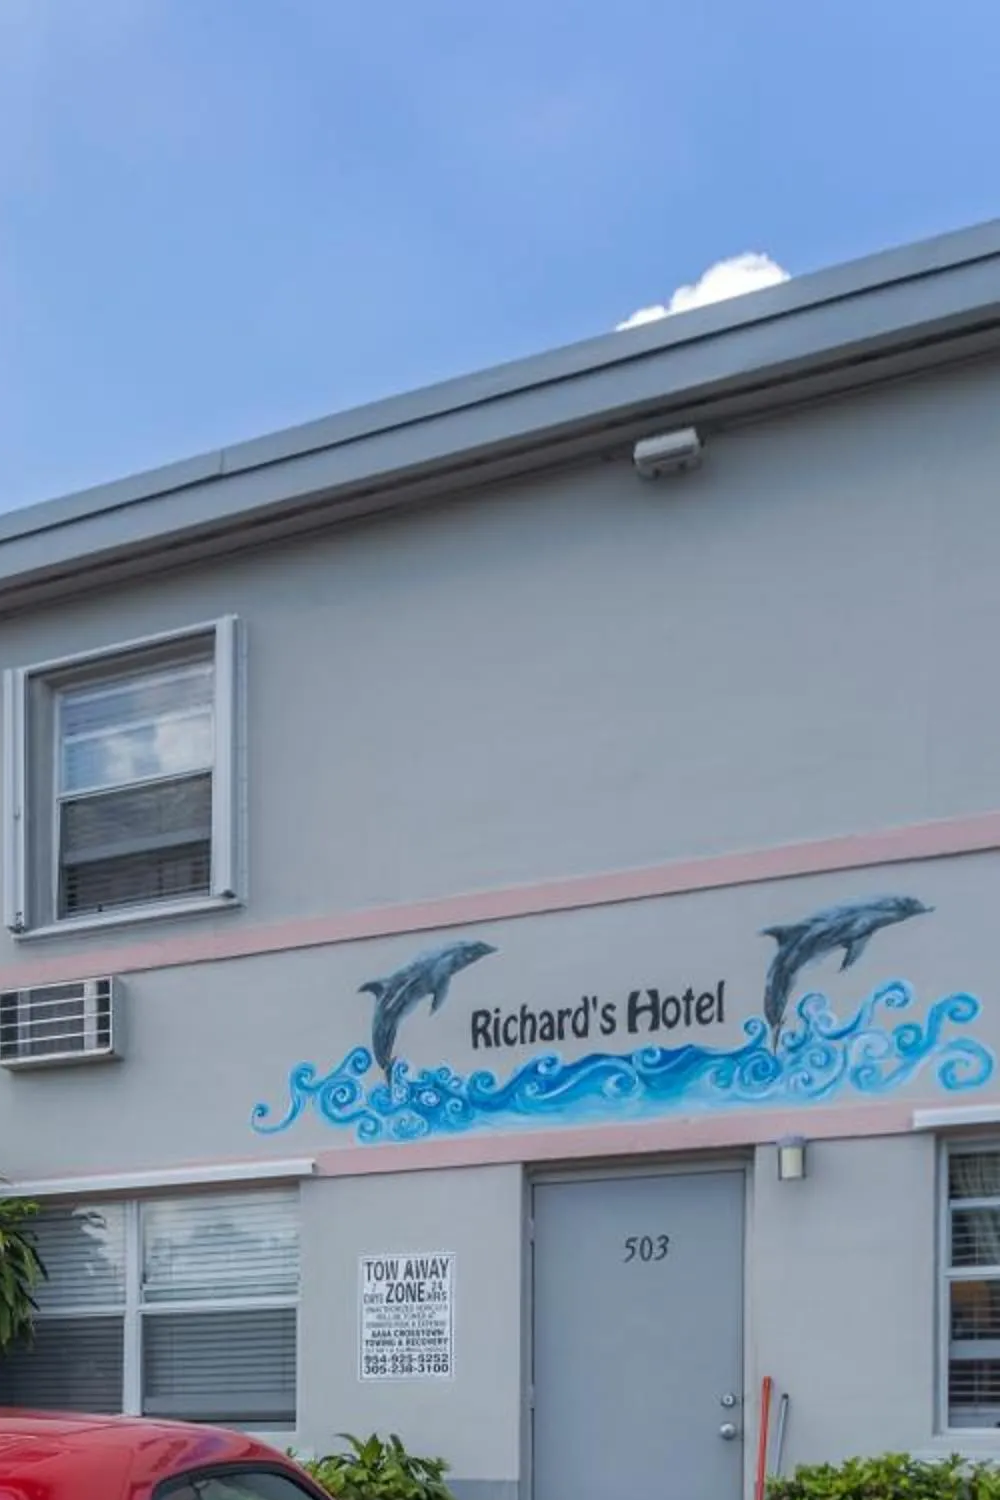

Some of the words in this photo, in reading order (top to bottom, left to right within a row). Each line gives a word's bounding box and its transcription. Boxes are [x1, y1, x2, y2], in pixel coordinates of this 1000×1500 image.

[471, 995, 616, 1049] Richard's
[627, 980, 725, 1034] Hotel
[624, 1234, 669, 1263] 503
[365, 1260, 399, 1281] TOW
[404, 1258, 449, 1280] AWAY
[385, 1281, 425, 1304] ZONE
